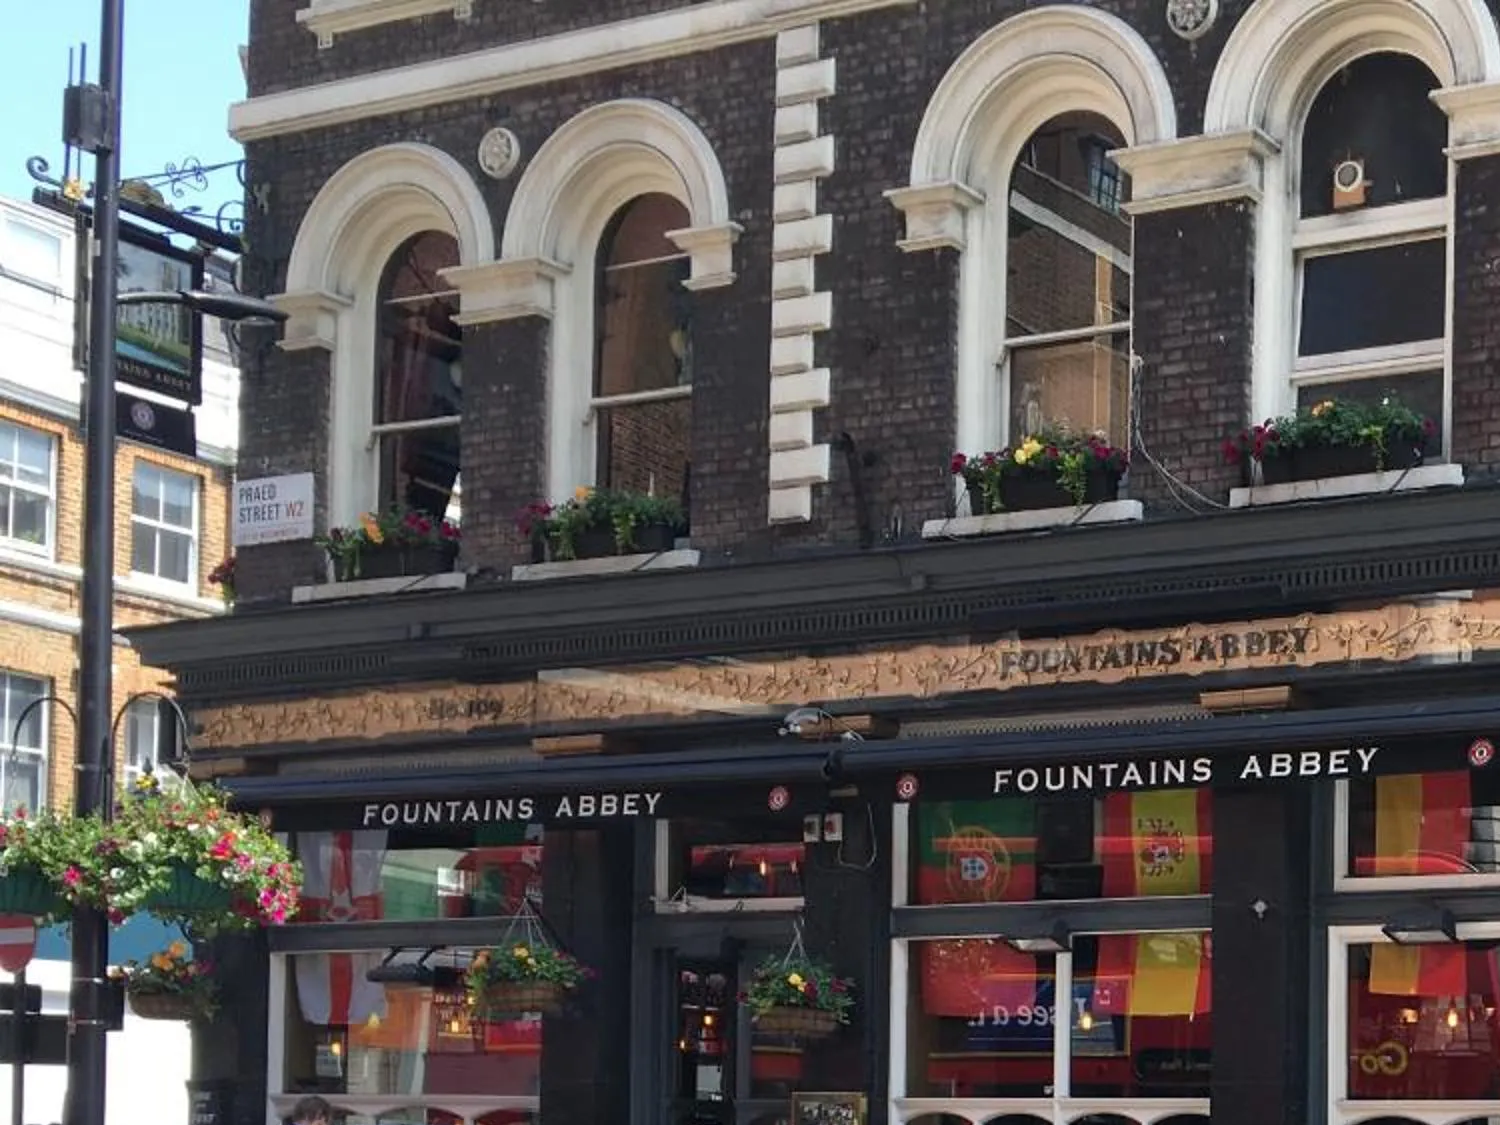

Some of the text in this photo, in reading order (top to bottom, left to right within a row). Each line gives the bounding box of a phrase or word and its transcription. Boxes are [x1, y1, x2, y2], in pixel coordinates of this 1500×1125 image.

[239, 484, 277, 504] PRAED
[239, 500, 304, 524] STREET W2
[1000, 626, 1311, 681] FOUNTAINS ABBEY
[993, 747, 1379, 793] FOUNTAINS ABBEY
[363, 792, 663, 826] FOUNTAINS ABBEY
